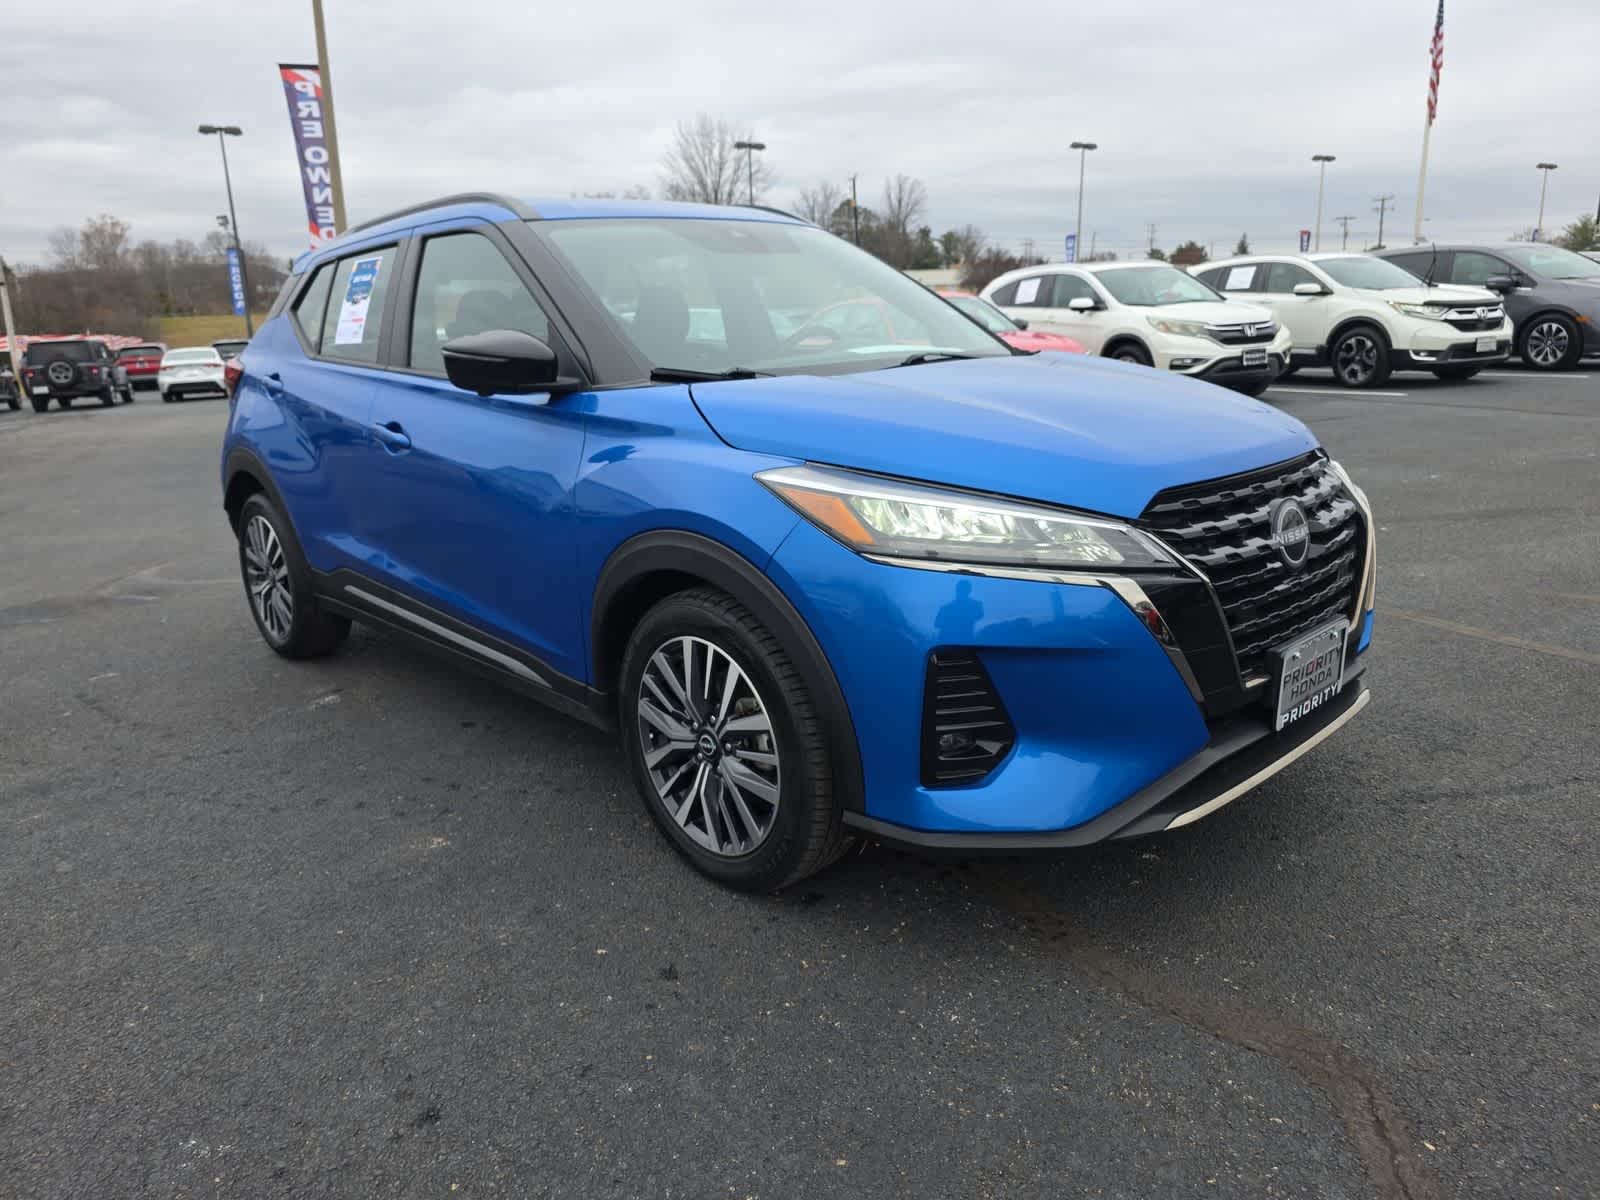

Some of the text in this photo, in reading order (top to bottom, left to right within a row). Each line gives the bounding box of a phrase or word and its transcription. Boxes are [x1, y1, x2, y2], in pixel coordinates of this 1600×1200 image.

[1272, 526, 1309, 544] NISSAN
[1283, 646, 1341, 688] PRIORITY
[1291, 667, 1332, 699] HONDA
[1281, 683, 1338, 728] PRIORITY
